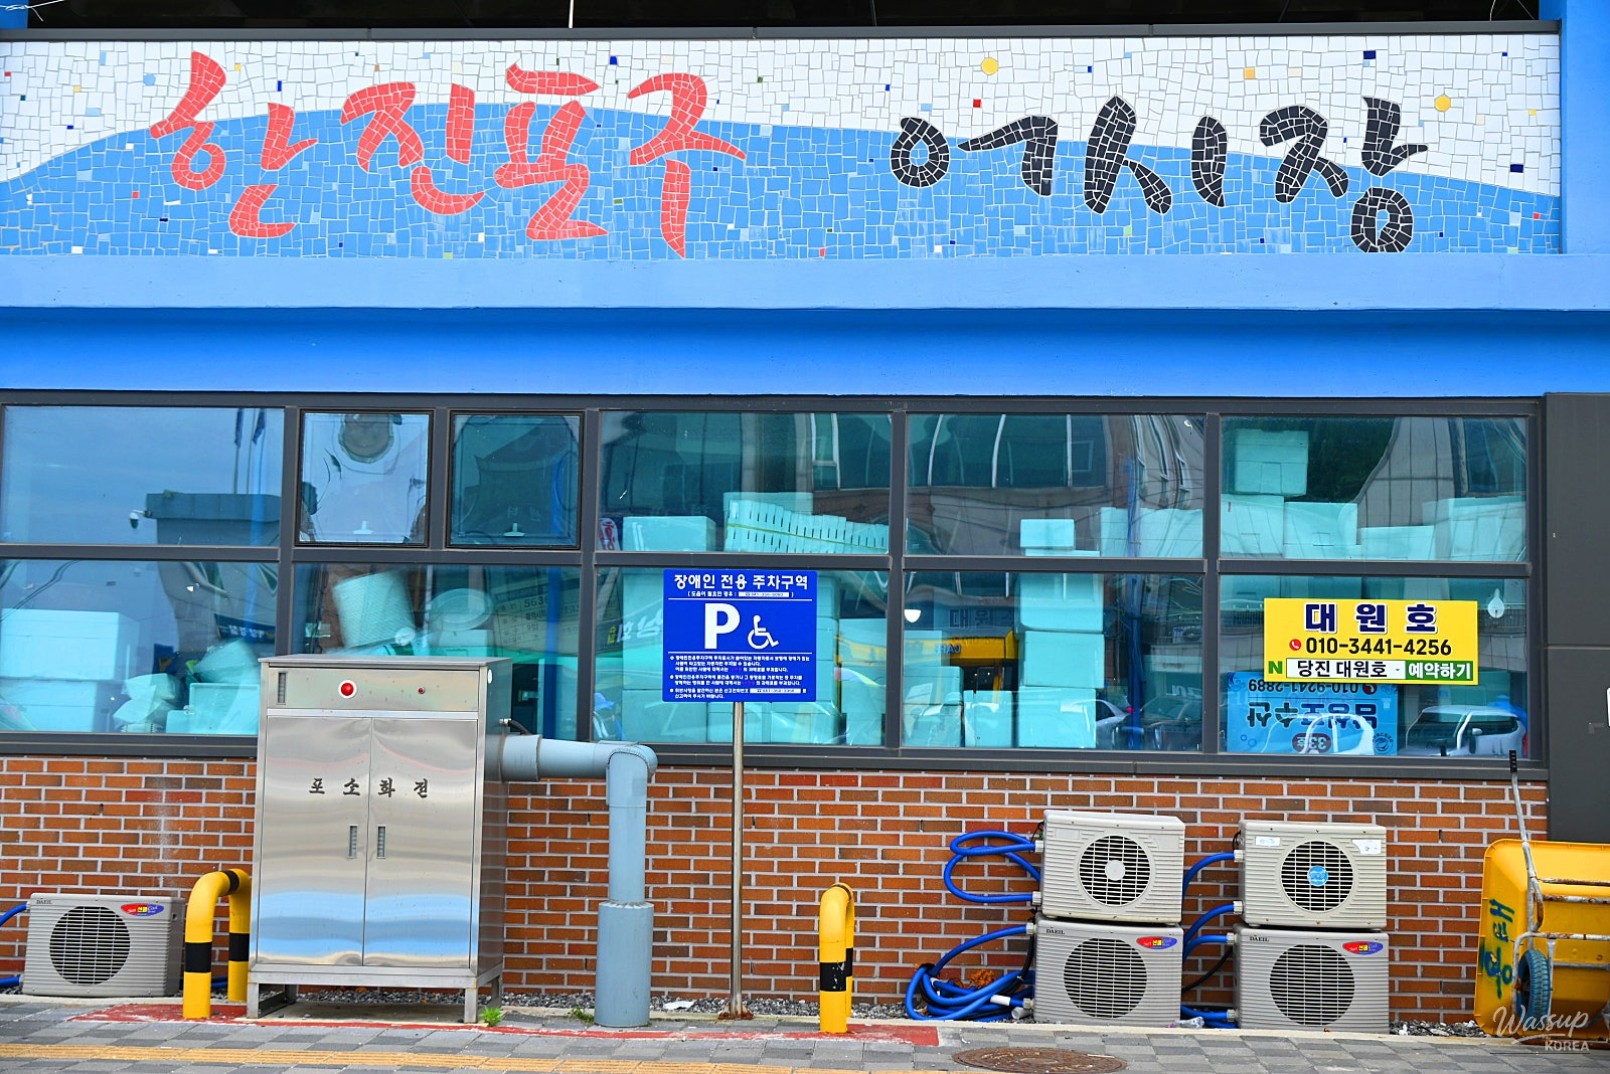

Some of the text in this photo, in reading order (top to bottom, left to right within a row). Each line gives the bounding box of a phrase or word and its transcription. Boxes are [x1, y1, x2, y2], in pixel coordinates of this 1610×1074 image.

[150, 50, 1428, 259] 한진포구 어시장
[674, 573, 808, 590] 장애인 전용 주차구역
[704, 603, 740, 650] P
[1305, 637, 1452, 656] 010-3441-4256
[1297, 660, 1330, 678] 당진
[1336, 660, 1388, 678] 대원호
[1408, 662, 1471, 680] 예약하기
